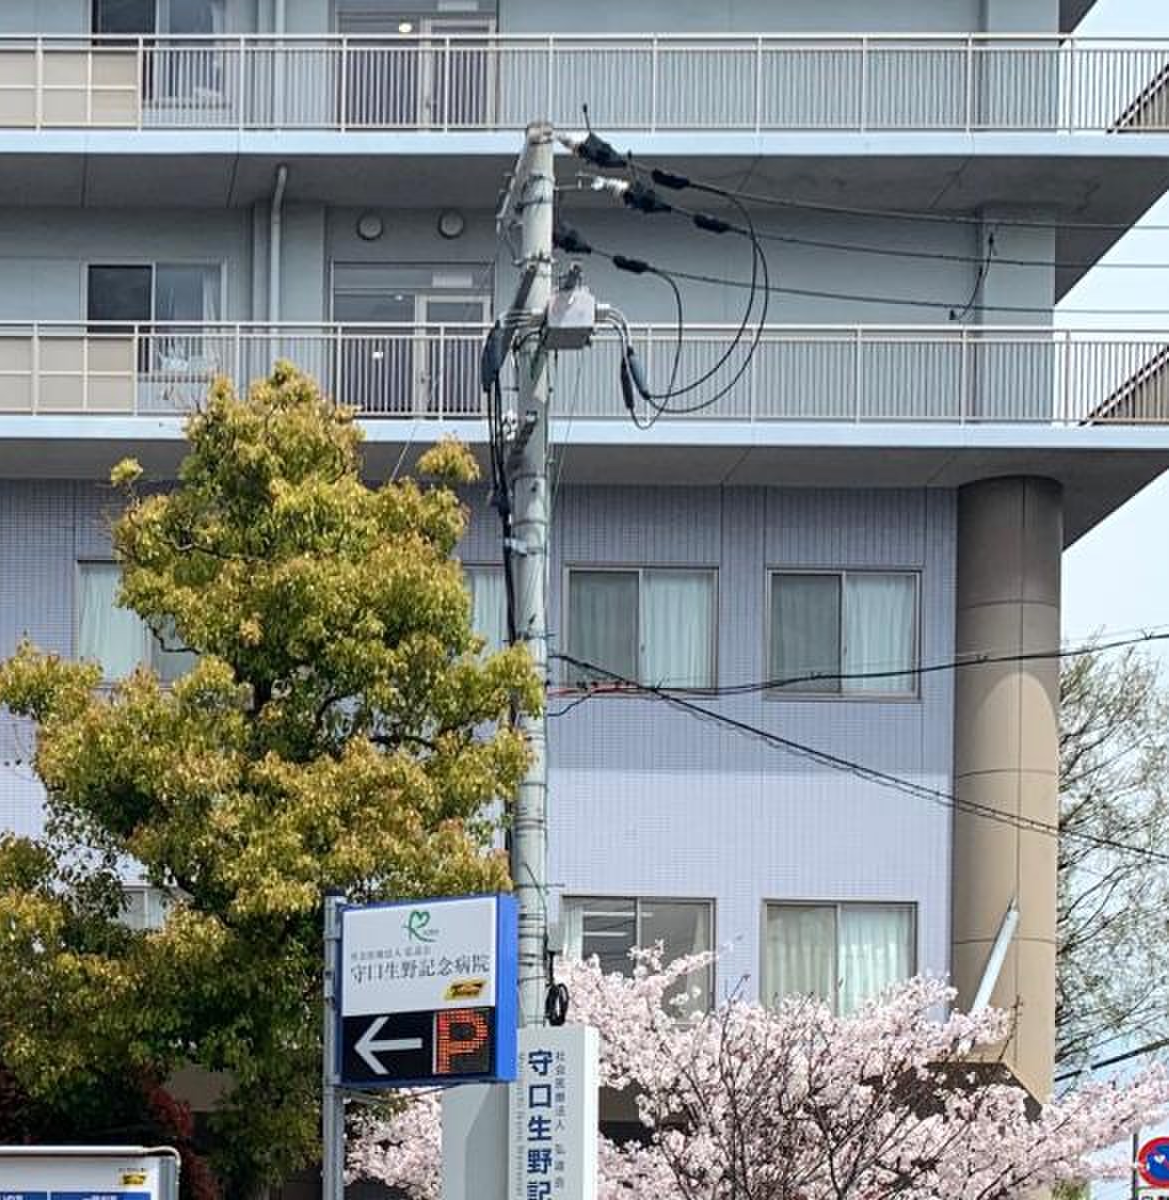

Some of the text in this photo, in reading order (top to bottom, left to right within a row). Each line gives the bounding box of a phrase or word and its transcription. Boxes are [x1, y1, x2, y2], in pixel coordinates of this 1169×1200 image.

[350, 954, 491, 984] 守口生野記念病院
[435, 1008, 489, 1074] P
